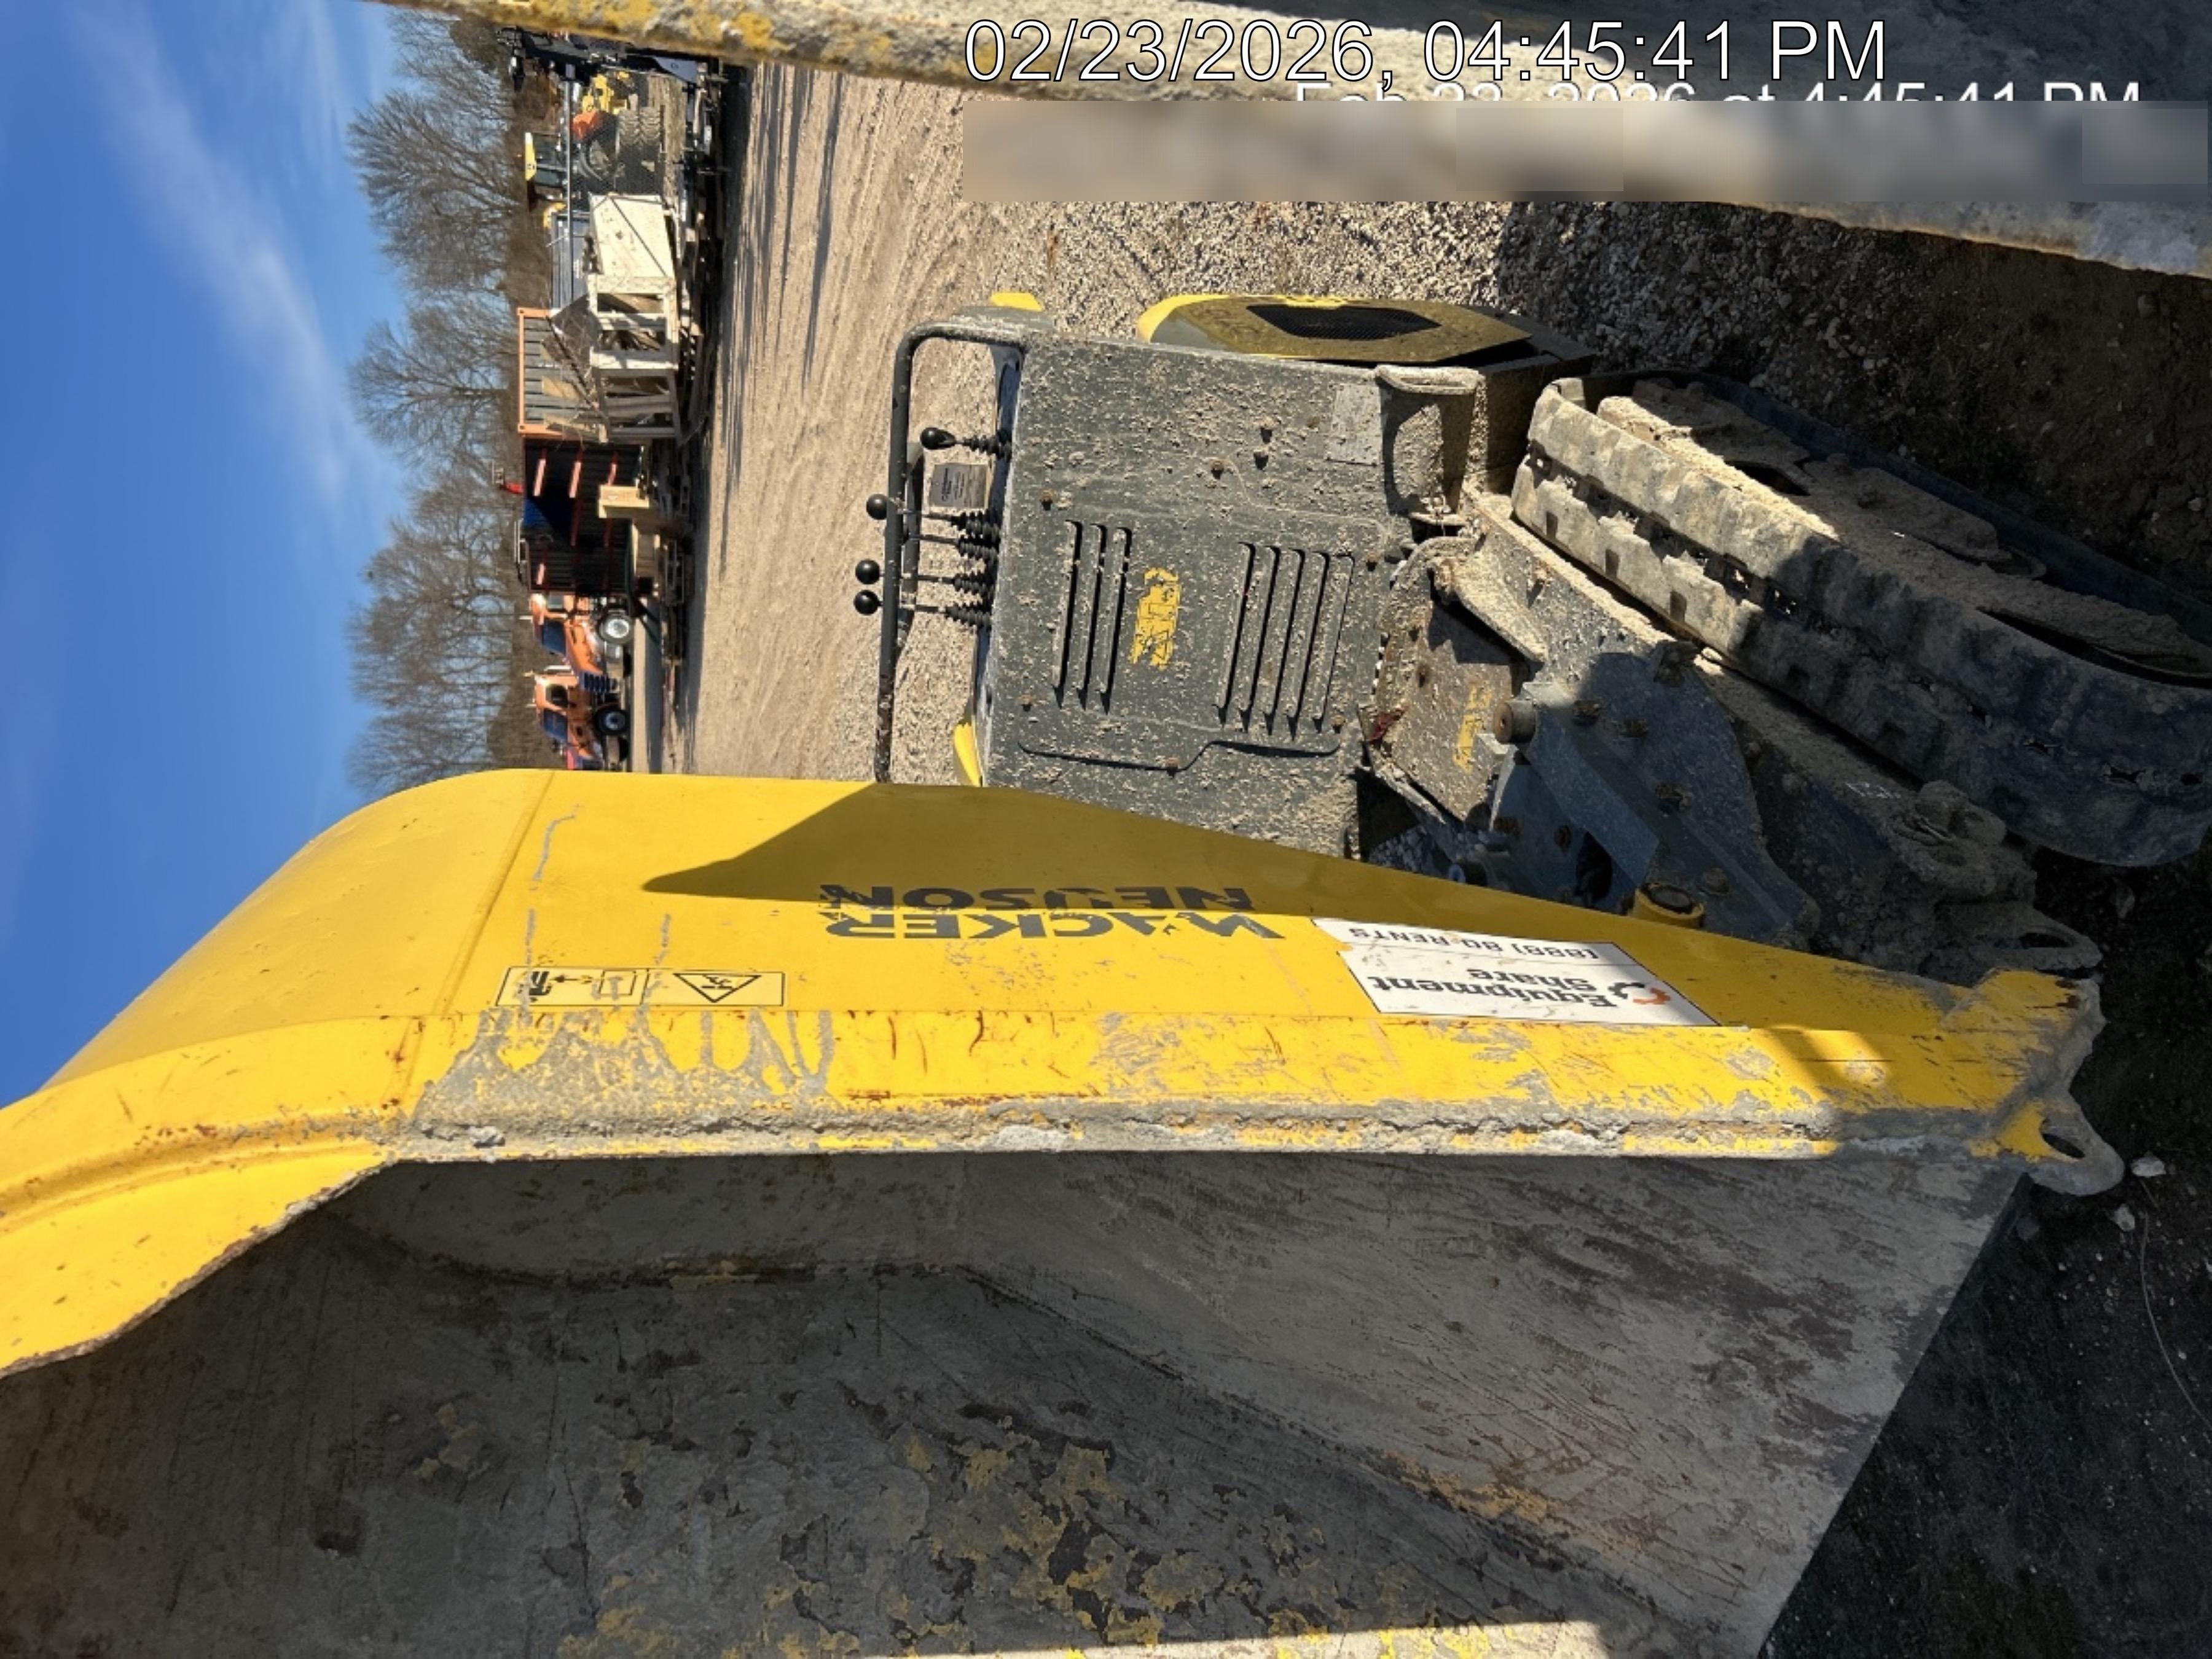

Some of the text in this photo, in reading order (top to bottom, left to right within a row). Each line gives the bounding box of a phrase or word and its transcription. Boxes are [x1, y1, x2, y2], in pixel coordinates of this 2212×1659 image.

[819, 885, 1257, 912] NEUSON
[819, 912, 1286, 939] WACKER
[1373, 977, 1617, 1007] Equipment
[1467, 969, 1598, 992] Share
